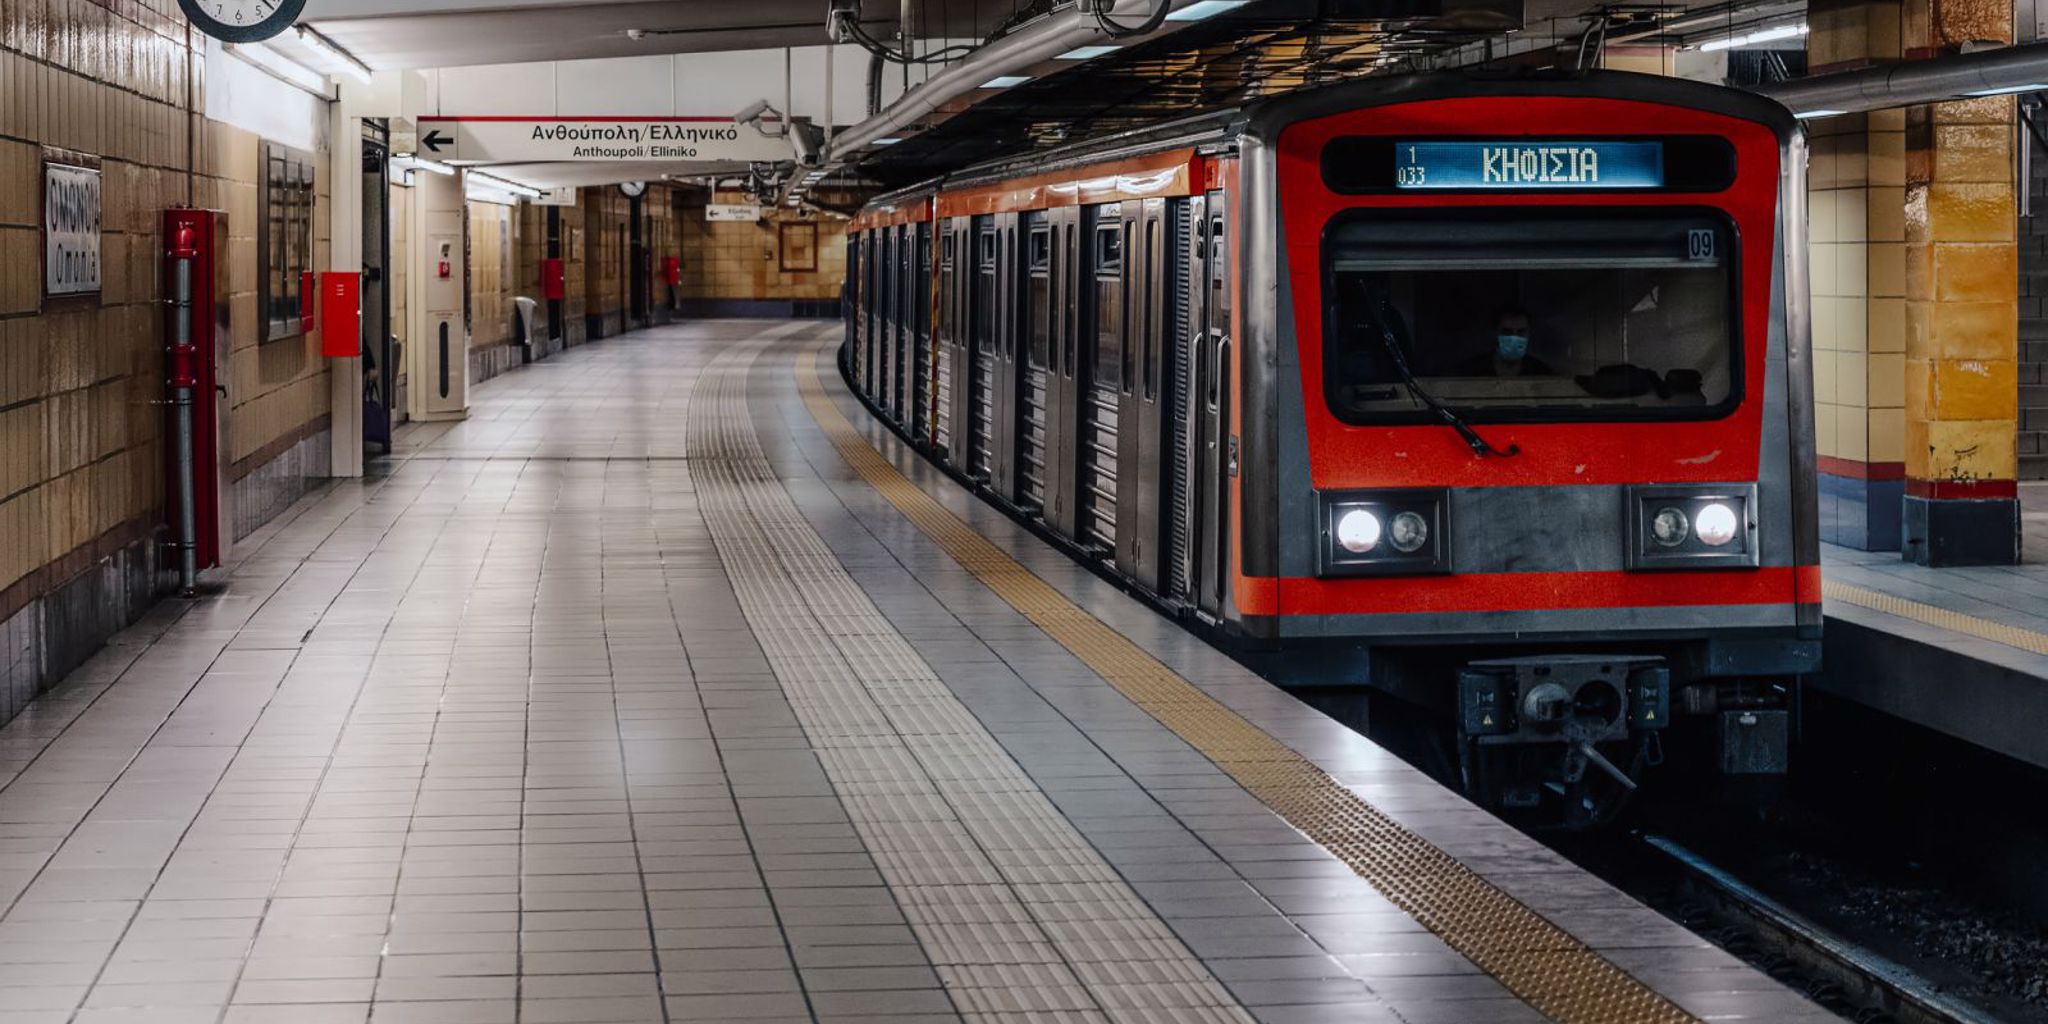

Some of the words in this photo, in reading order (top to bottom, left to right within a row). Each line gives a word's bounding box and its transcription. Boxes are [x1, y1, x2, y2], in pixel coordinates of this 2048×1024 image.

[216, 4, 222, 15] 7
[235, 9, 242, 20] 6
[256, 5, 262, 16] 5
[532, 124, 738, 143] Ανθούπολη/Ελληνικό
[573, 146, 697, 159] Anthoupoli/Elliniko
[1408, 146, 1416, 164] 1
[1483, 148, 1599, 183] ΚΗΦΙΣΙΑ
[1398, 166, 1425, 185] 033
[1691, 231, 1712, 257] 09
[56, 243, 96, 285] Omonia
